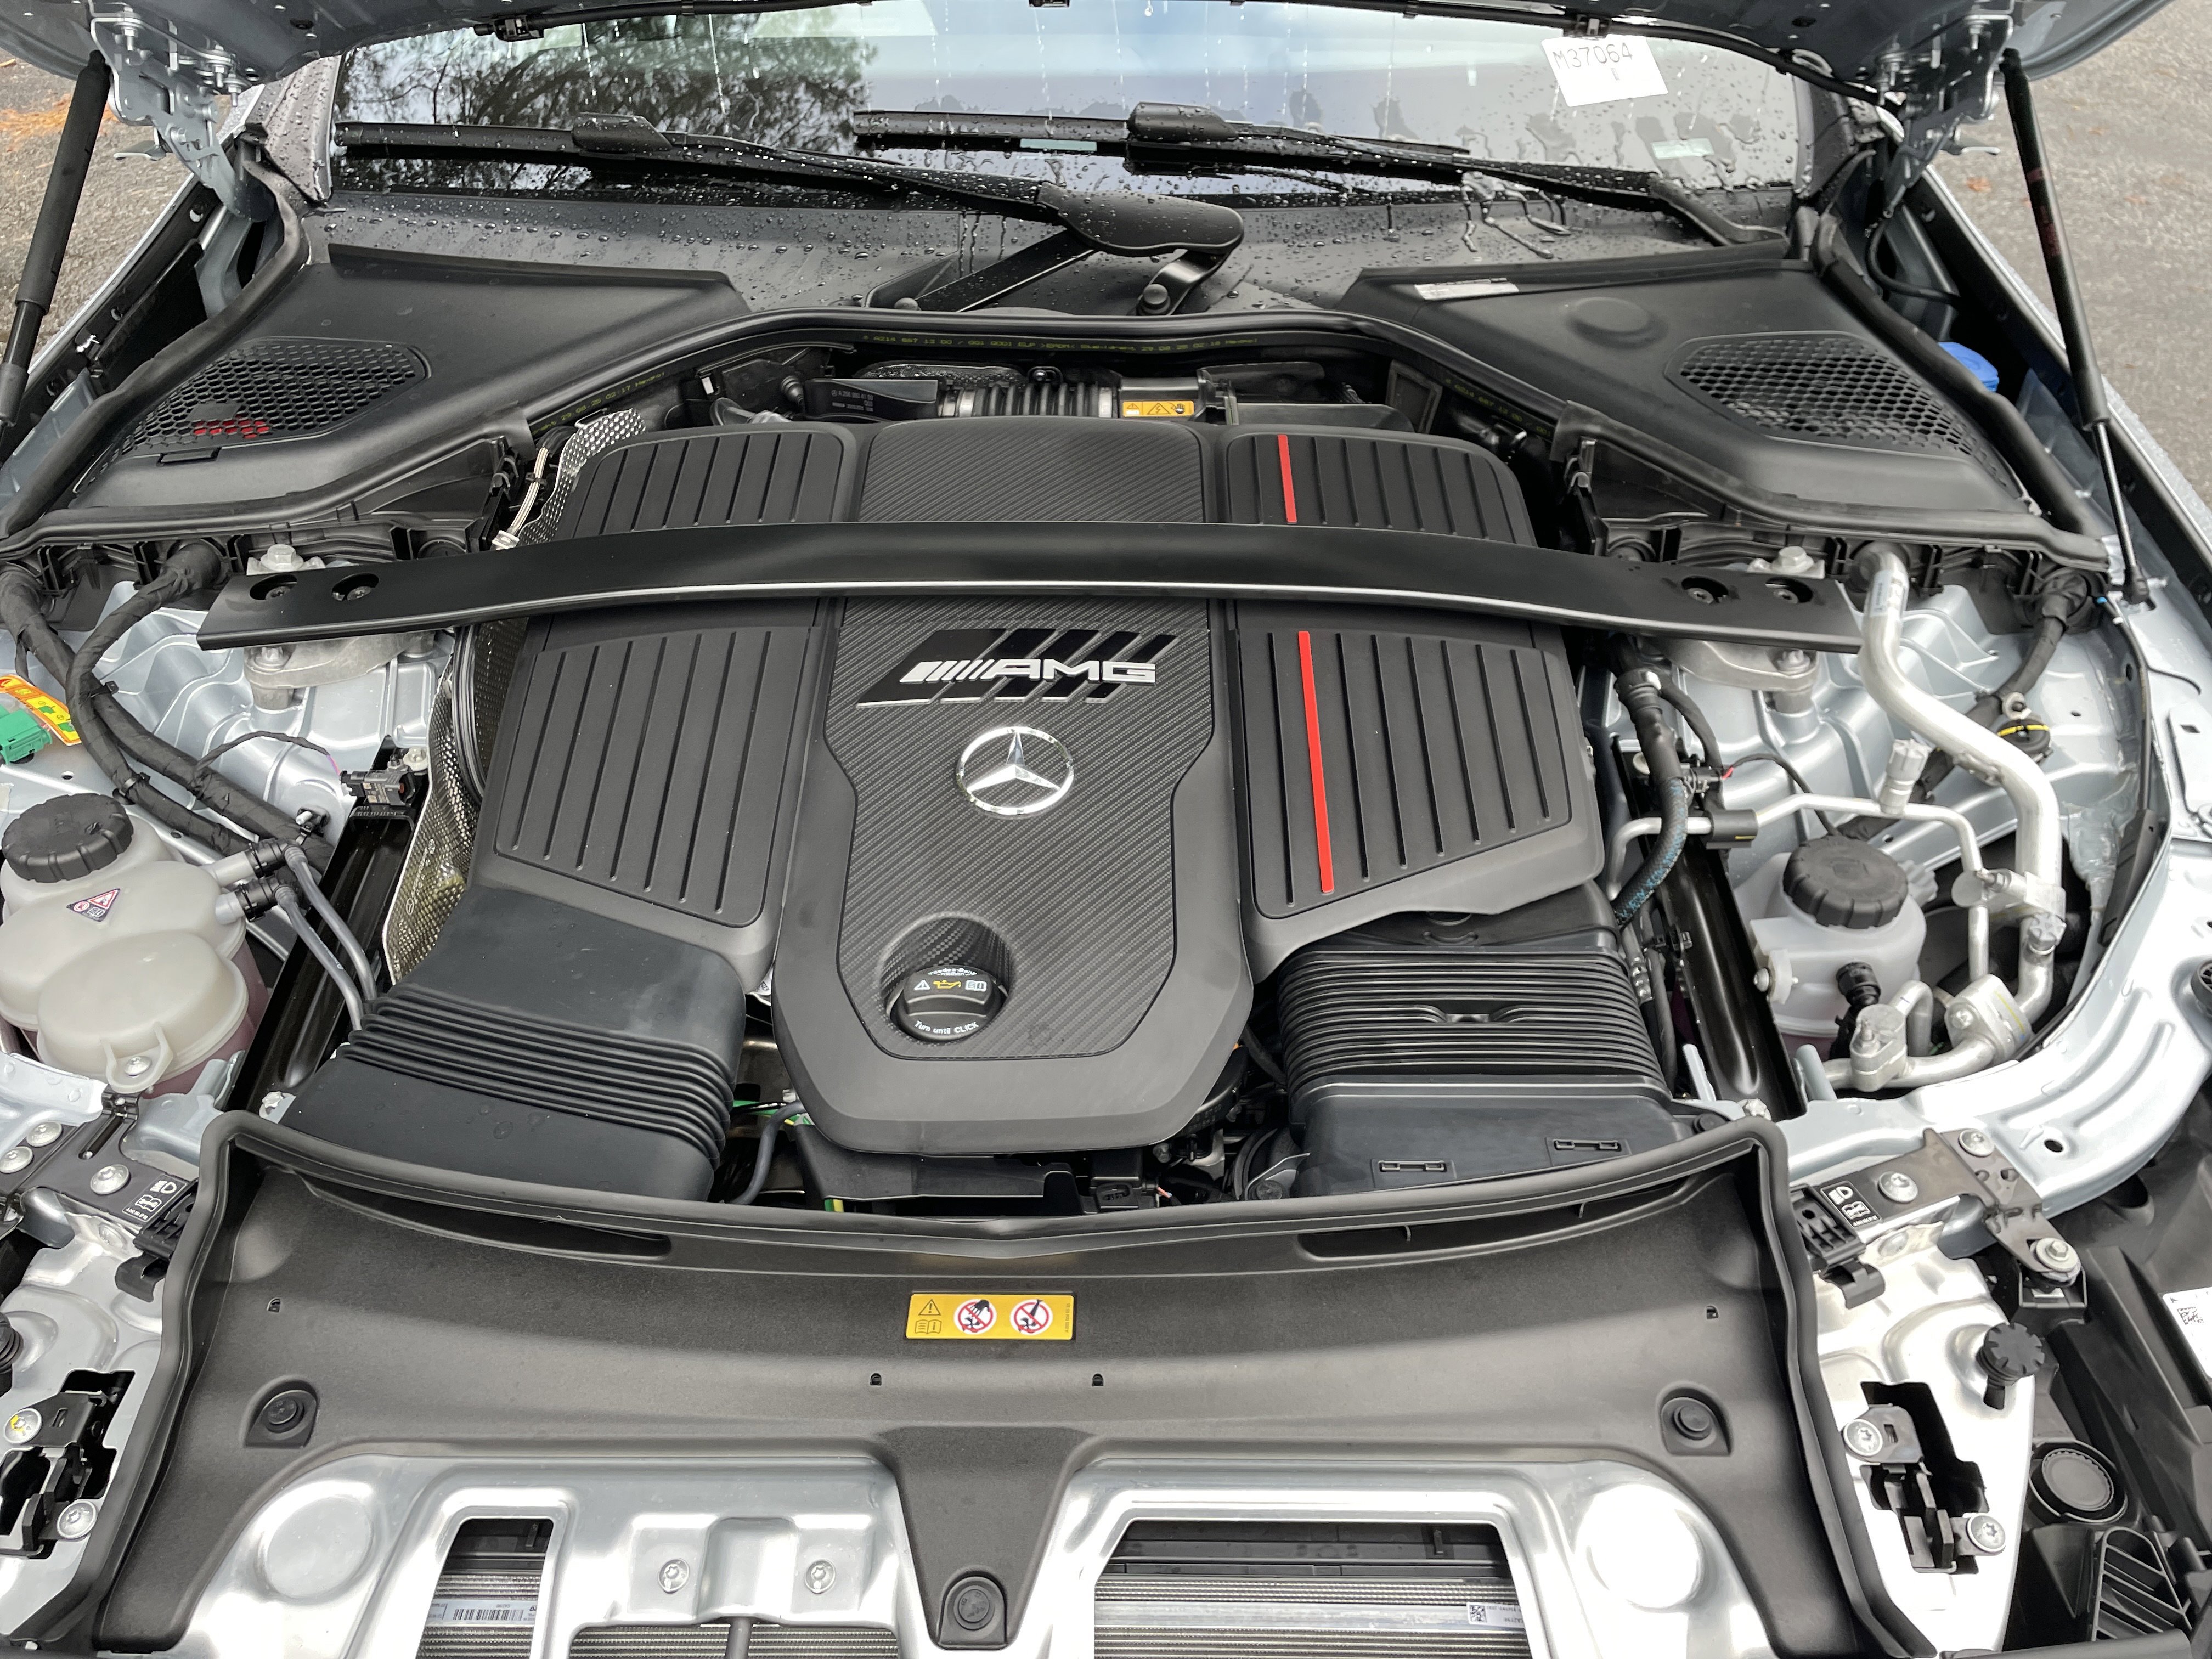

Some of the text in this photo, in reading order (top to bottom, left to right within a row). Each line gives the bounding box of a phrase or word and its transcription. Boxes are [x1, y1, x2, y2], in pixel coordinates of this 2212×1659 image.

[1552, 42, 1633, 69] M37064
[980, 658, 1156, 684] AMG
[915, 1020, 932, 1032] Turn
[954, 1022, 979, 1034] CLICK
